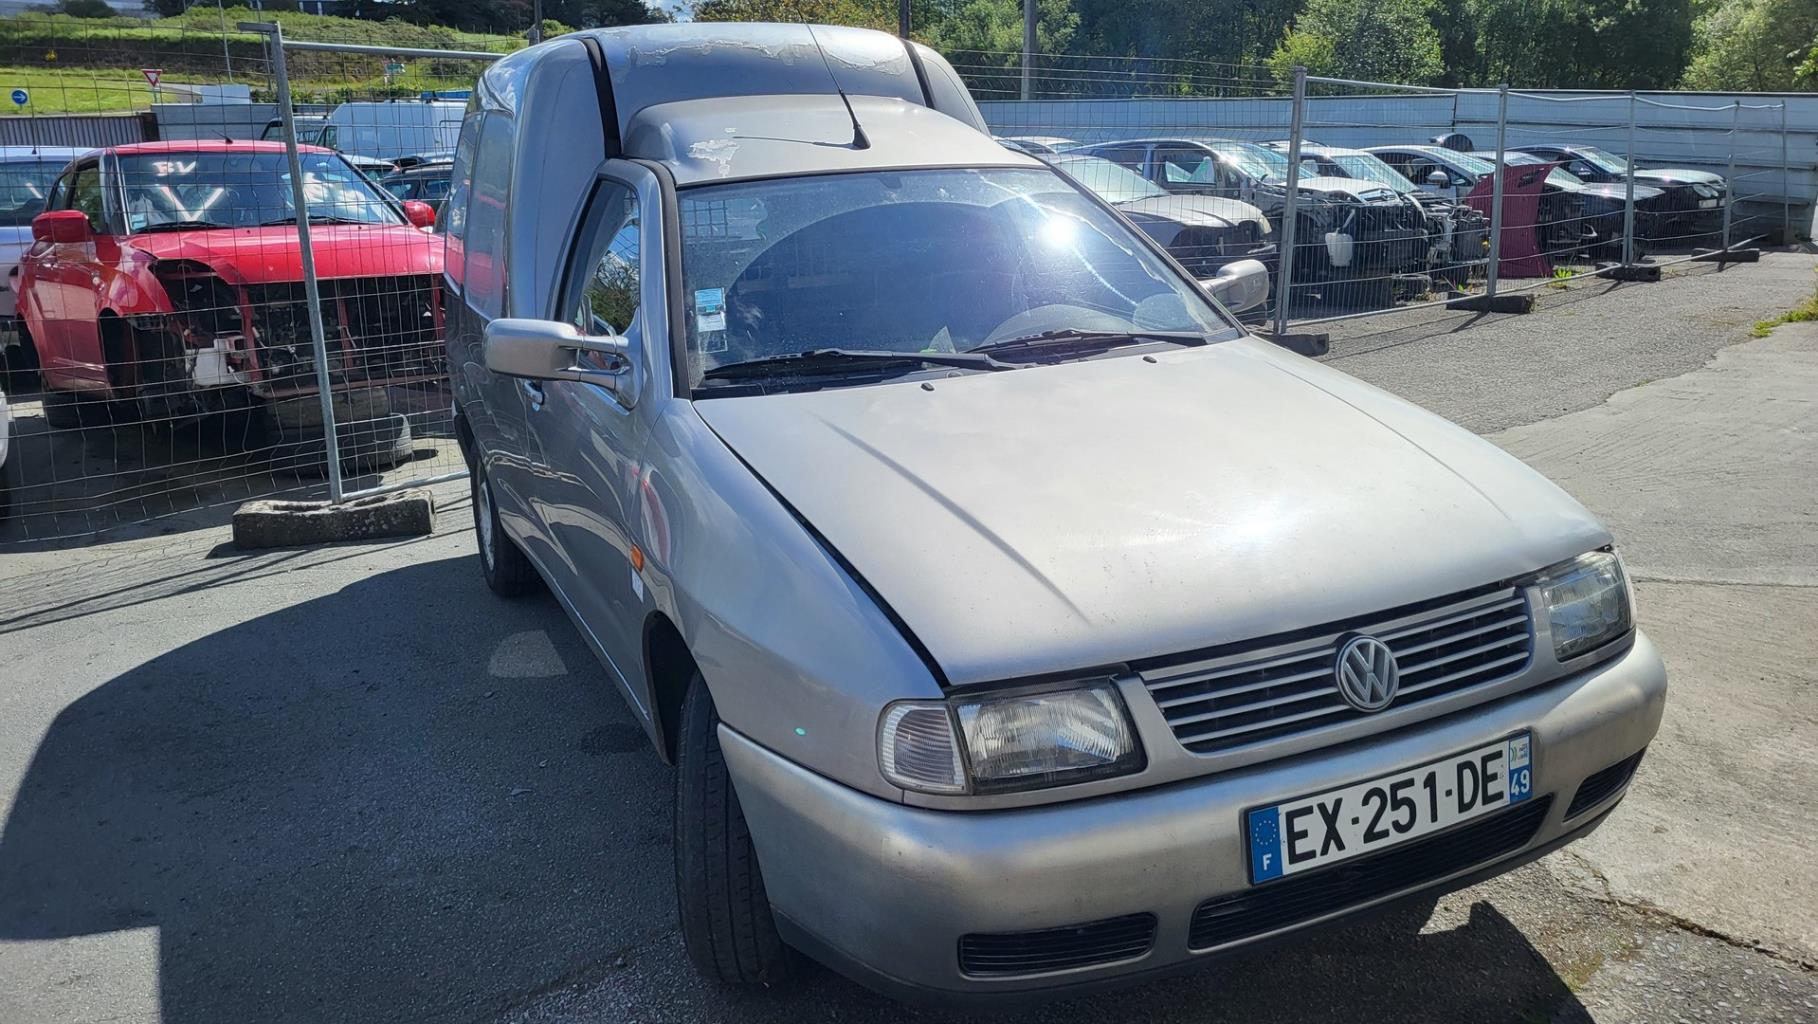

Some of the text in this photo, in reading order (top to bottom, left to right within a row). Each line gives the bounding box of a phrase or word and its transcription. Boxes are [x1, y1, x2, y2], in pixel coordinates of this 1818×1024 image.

[1338, 637, 1397, 710] VW
[1511, 769, 1530, 796] 49
[1262, 853, 1272, 871] F
